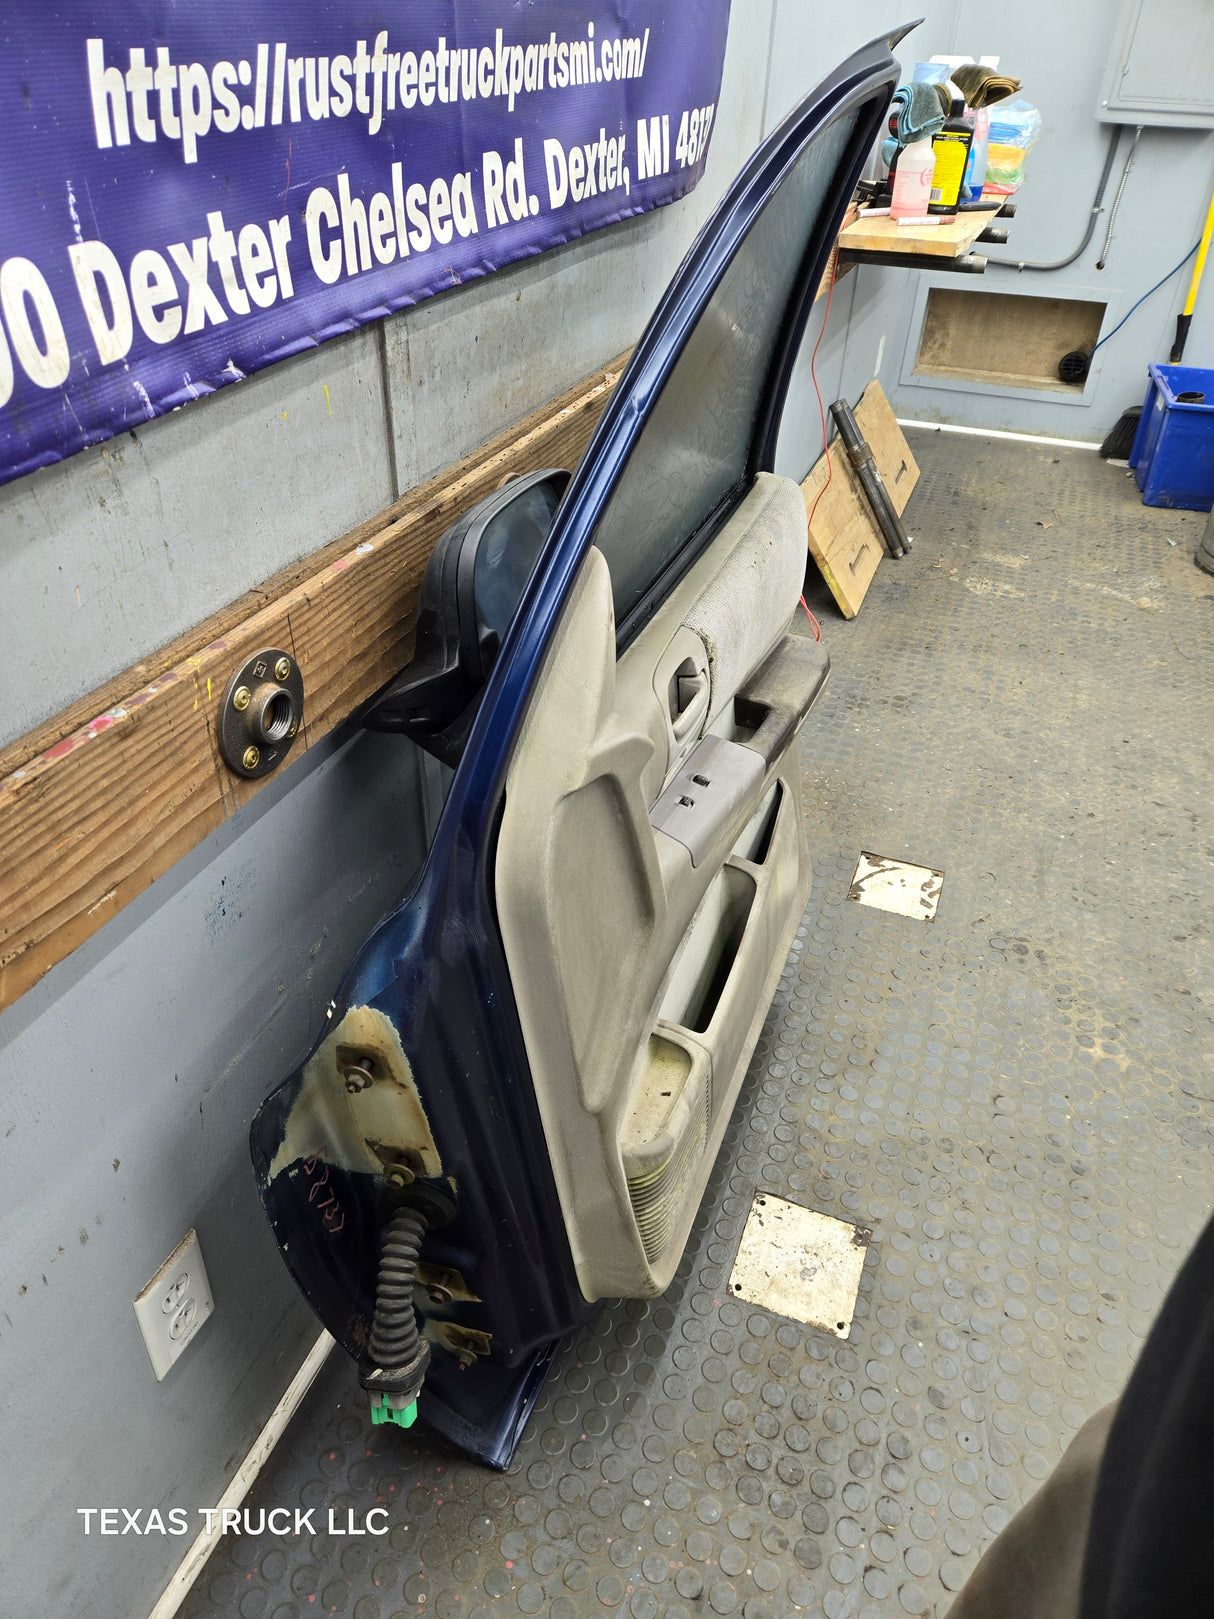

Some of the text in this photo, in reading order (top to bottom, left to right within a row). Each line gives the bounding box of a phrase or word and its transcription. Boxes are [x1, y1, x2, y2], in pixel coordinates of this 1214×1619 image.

[86, 22, 650, 163] https://rustfreetruckpartsmi.com/
[68, 211, 294, 366] Dexter
[306, 162, 479, 284] Chelsea
[482, 137, 540, 229] Rd.
[544, 128, 630, 210] Dexter,
[637, 115, 670, 180] MI
